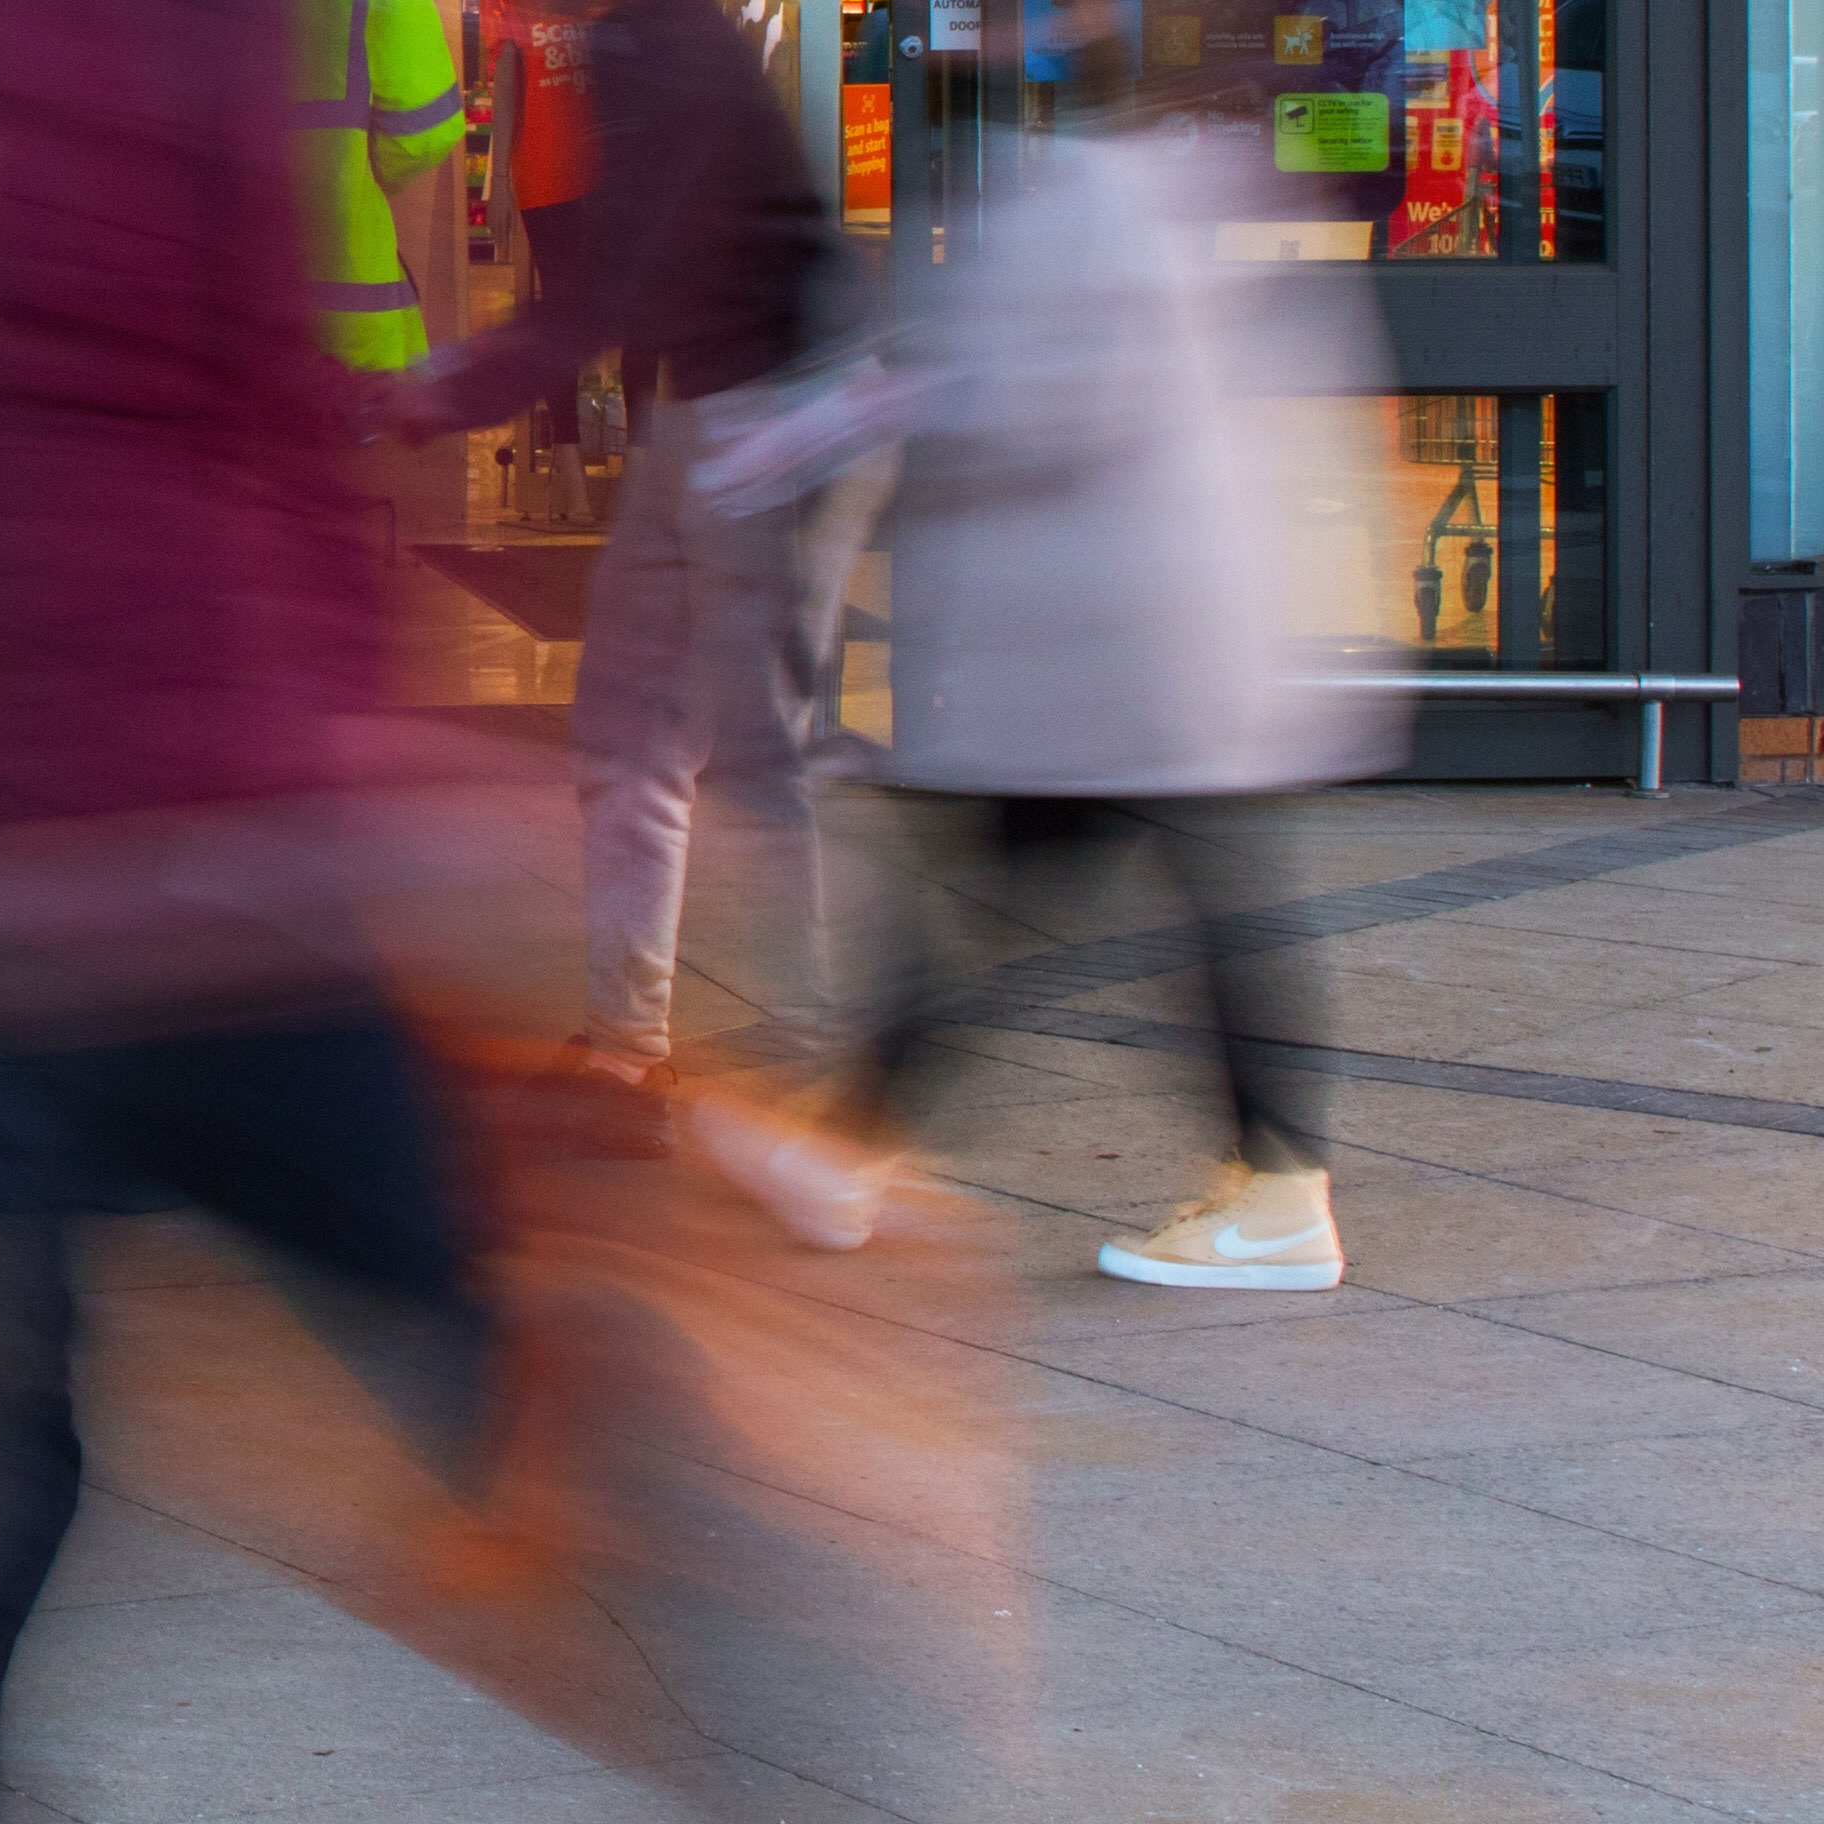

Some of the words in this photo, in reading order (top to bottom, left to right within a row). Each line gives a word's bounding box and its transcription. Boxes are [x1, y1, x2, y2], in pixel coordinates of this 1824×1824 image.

[933, 0, 982, 9] AUTOMA
[1207, 111, 1224, 121] No
[845, 124, 865, 138] Scan
[873, 118, 889, 135] bag
[1208, 120, 1262, 136] smoking
[847, 140, 864, 157] and
[864, 137, 886, 153] start
[1319, 138, 1349, 146] Security
[847, 157, 886, 176] shopping
